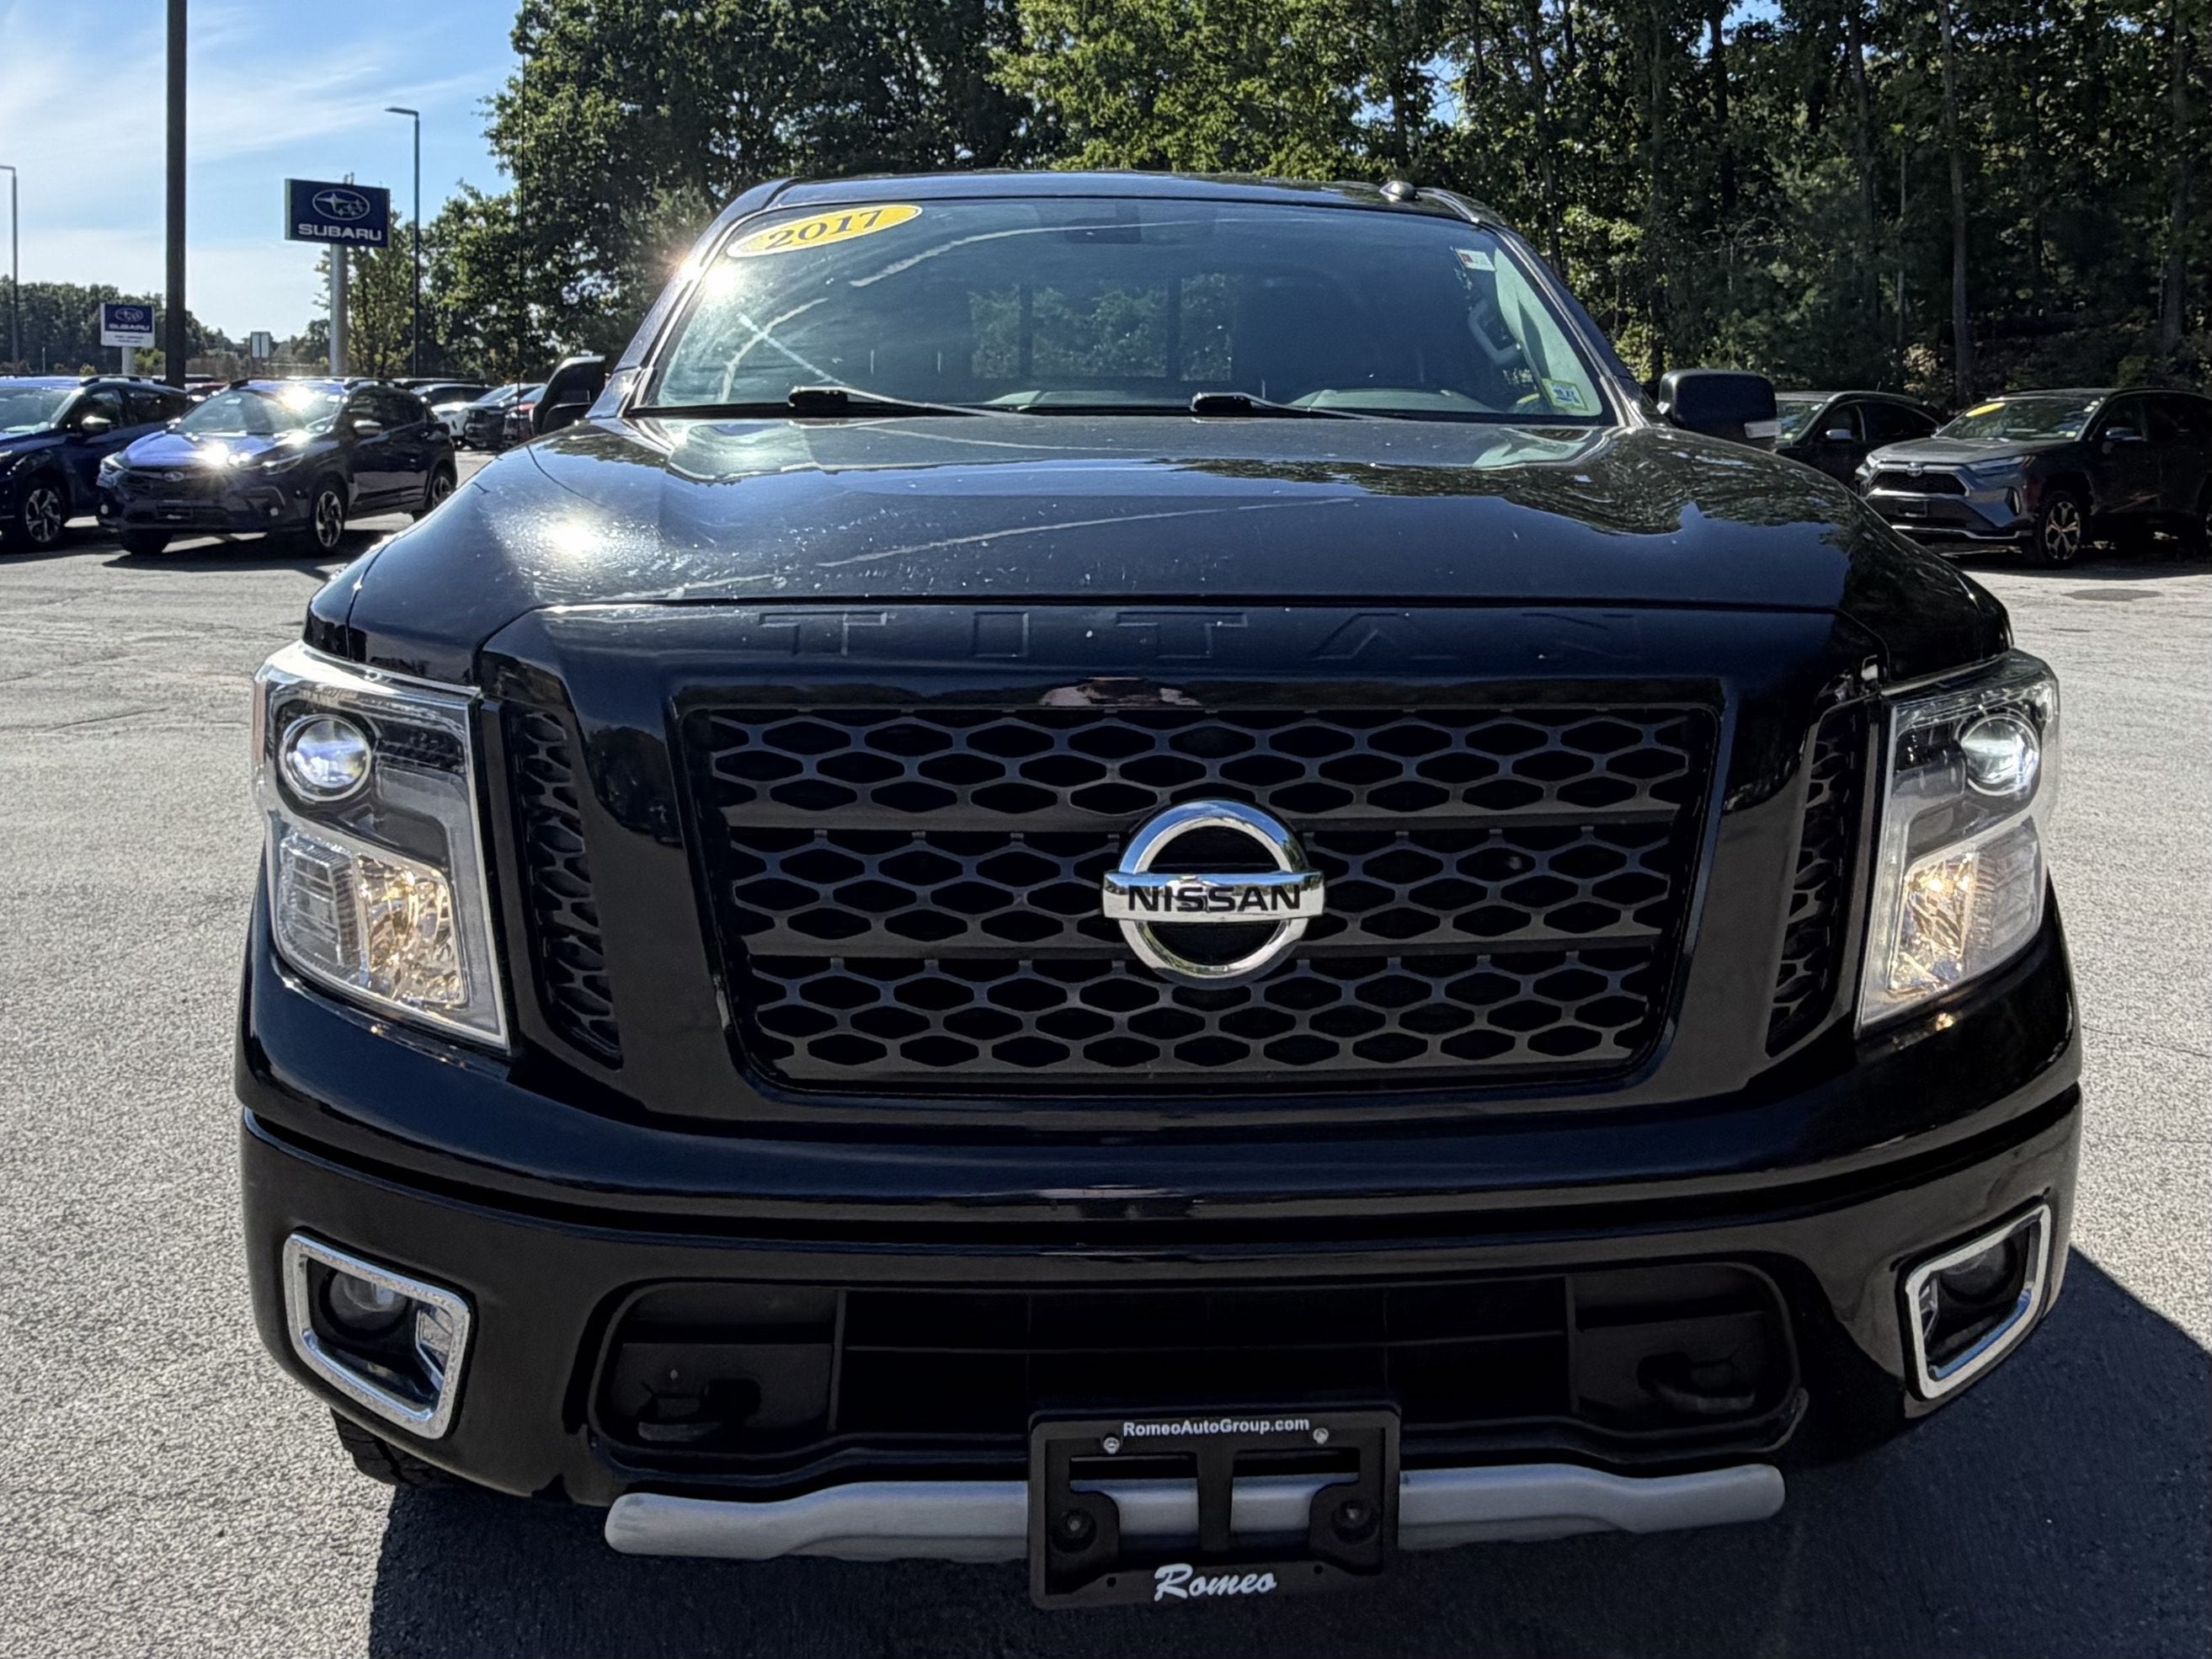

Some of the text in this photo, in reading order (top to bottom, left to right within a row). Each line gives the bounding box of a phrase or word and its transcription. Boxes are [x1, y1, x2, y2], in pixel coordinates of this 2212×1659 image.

[297, 222, 382, 242] SUBARU
[764, 209, 883, 251] 2017
[758, 611, 1642, 661] TITAN
[1128, 884, 1301, 913] NISSAN
[1122, 1418, 1310, 1438] RomeoAutoGroup.com
[1154, 1562, 1277, 1602] Romeo
